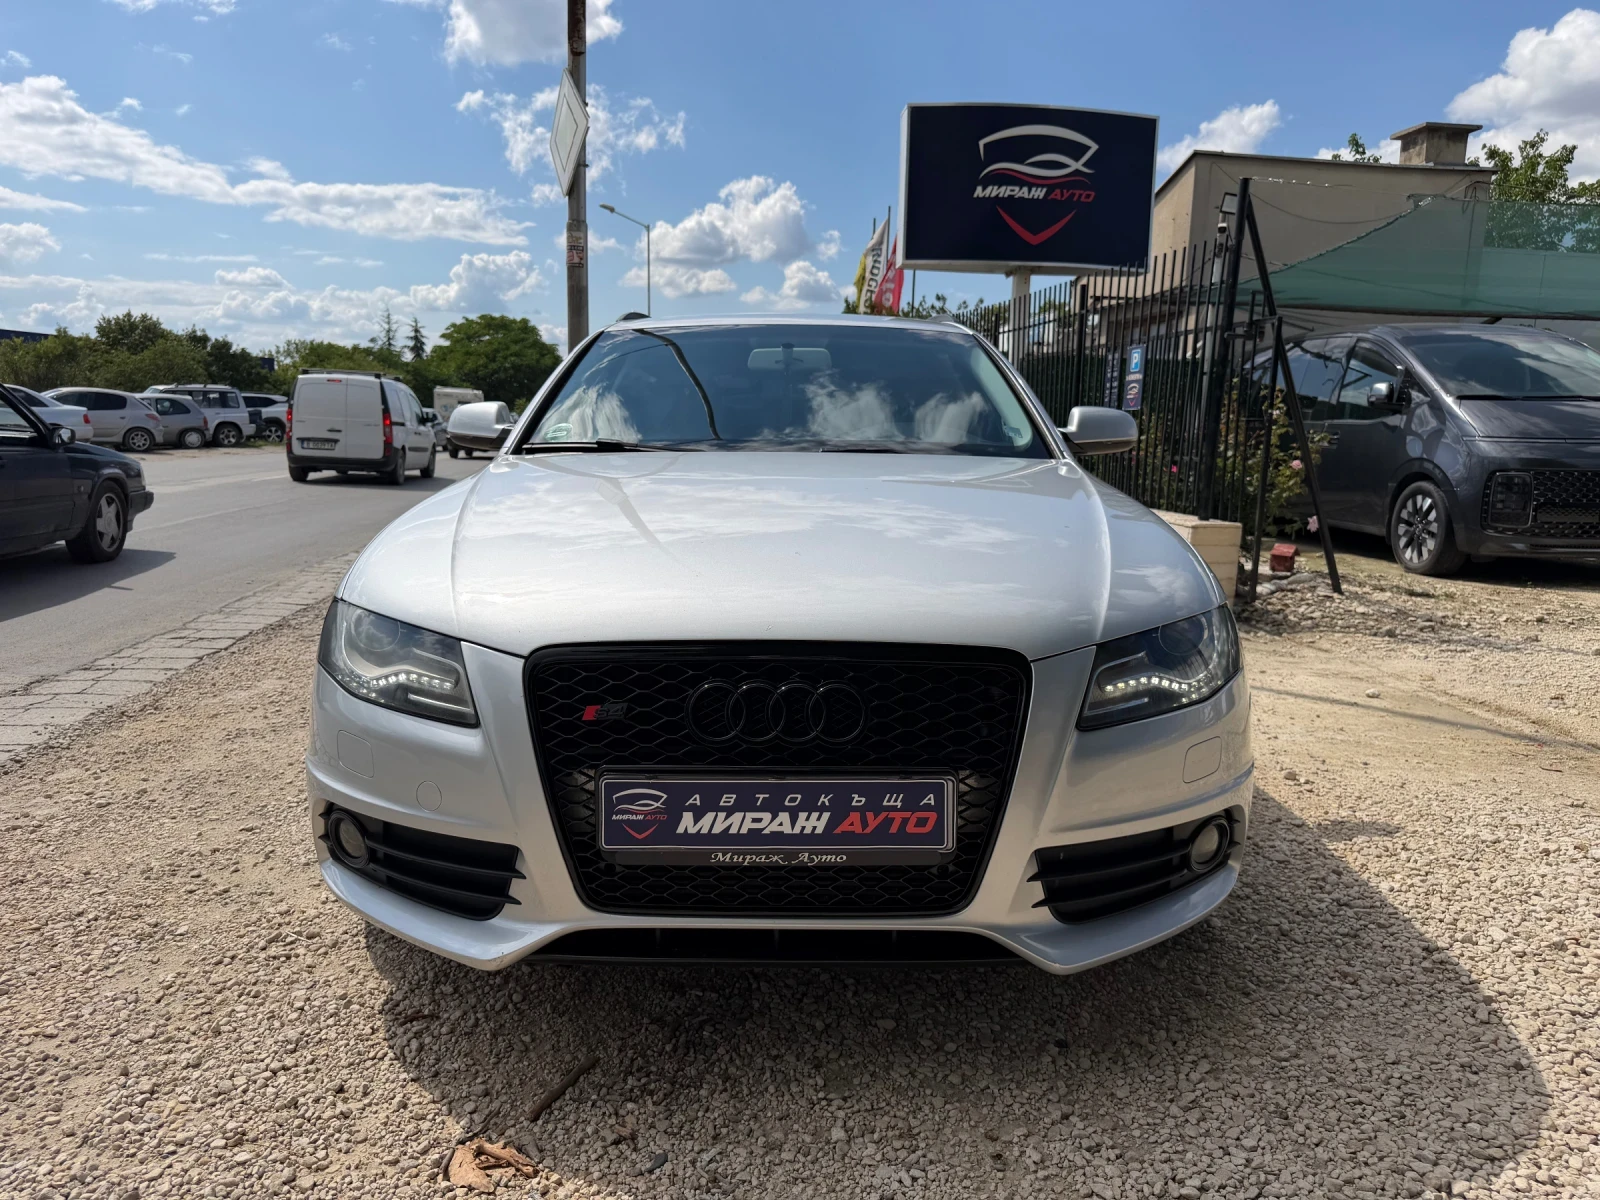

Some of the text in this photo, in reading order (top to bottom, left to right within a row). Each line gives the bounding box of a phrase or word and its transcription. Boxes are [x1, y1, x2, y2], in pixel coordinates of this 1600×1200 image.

[973, 185, 1096, 203] МИРАЖ АУТО
[685, 793, 936, 809] АВТОКЪЩА
[675, 811, 938, 834] МИРАЖ АУТО
[709, 852, 847, 866] Мираж Ауто
